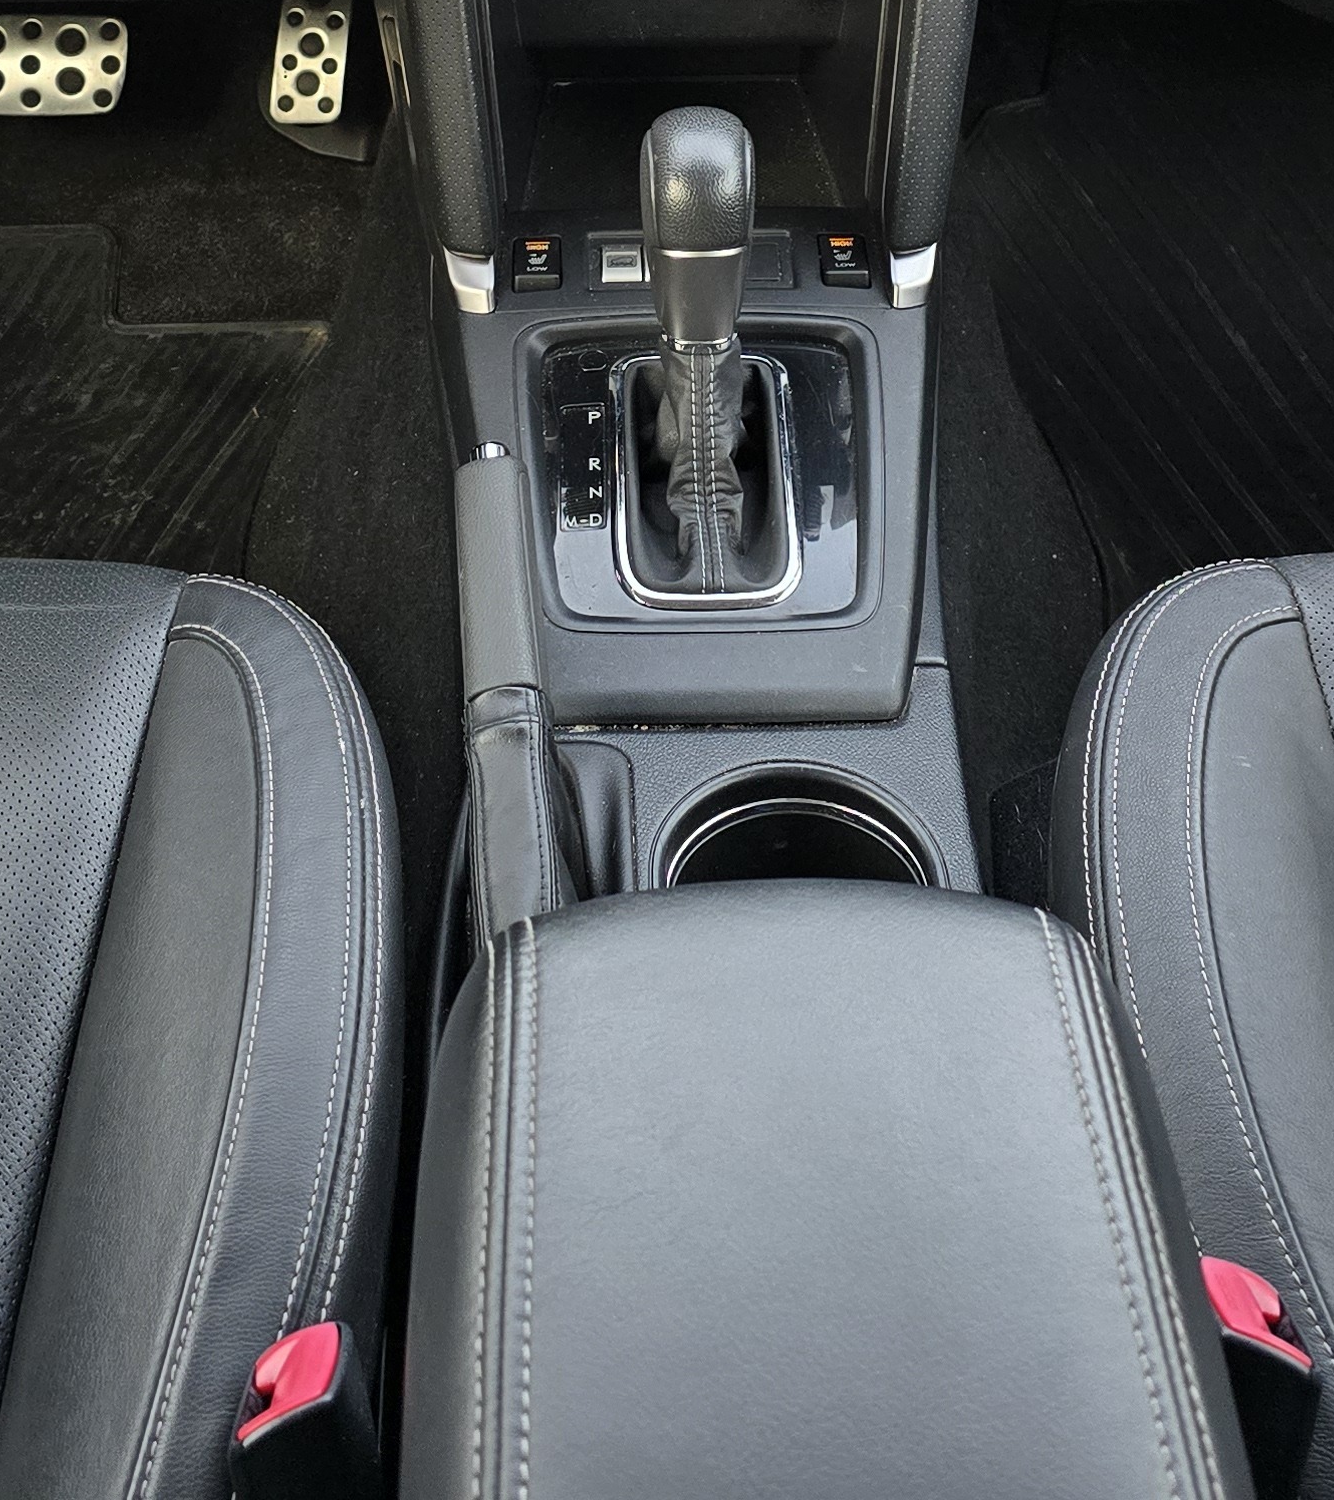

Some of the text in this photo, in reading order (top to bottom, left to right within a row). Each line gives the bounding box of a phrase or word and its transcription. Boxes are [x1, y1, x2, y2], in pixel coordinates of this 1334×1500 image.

[588, 411, 602, 425] P
[589, 457, 602, 471] R
[589, 486, 603, 499] N
